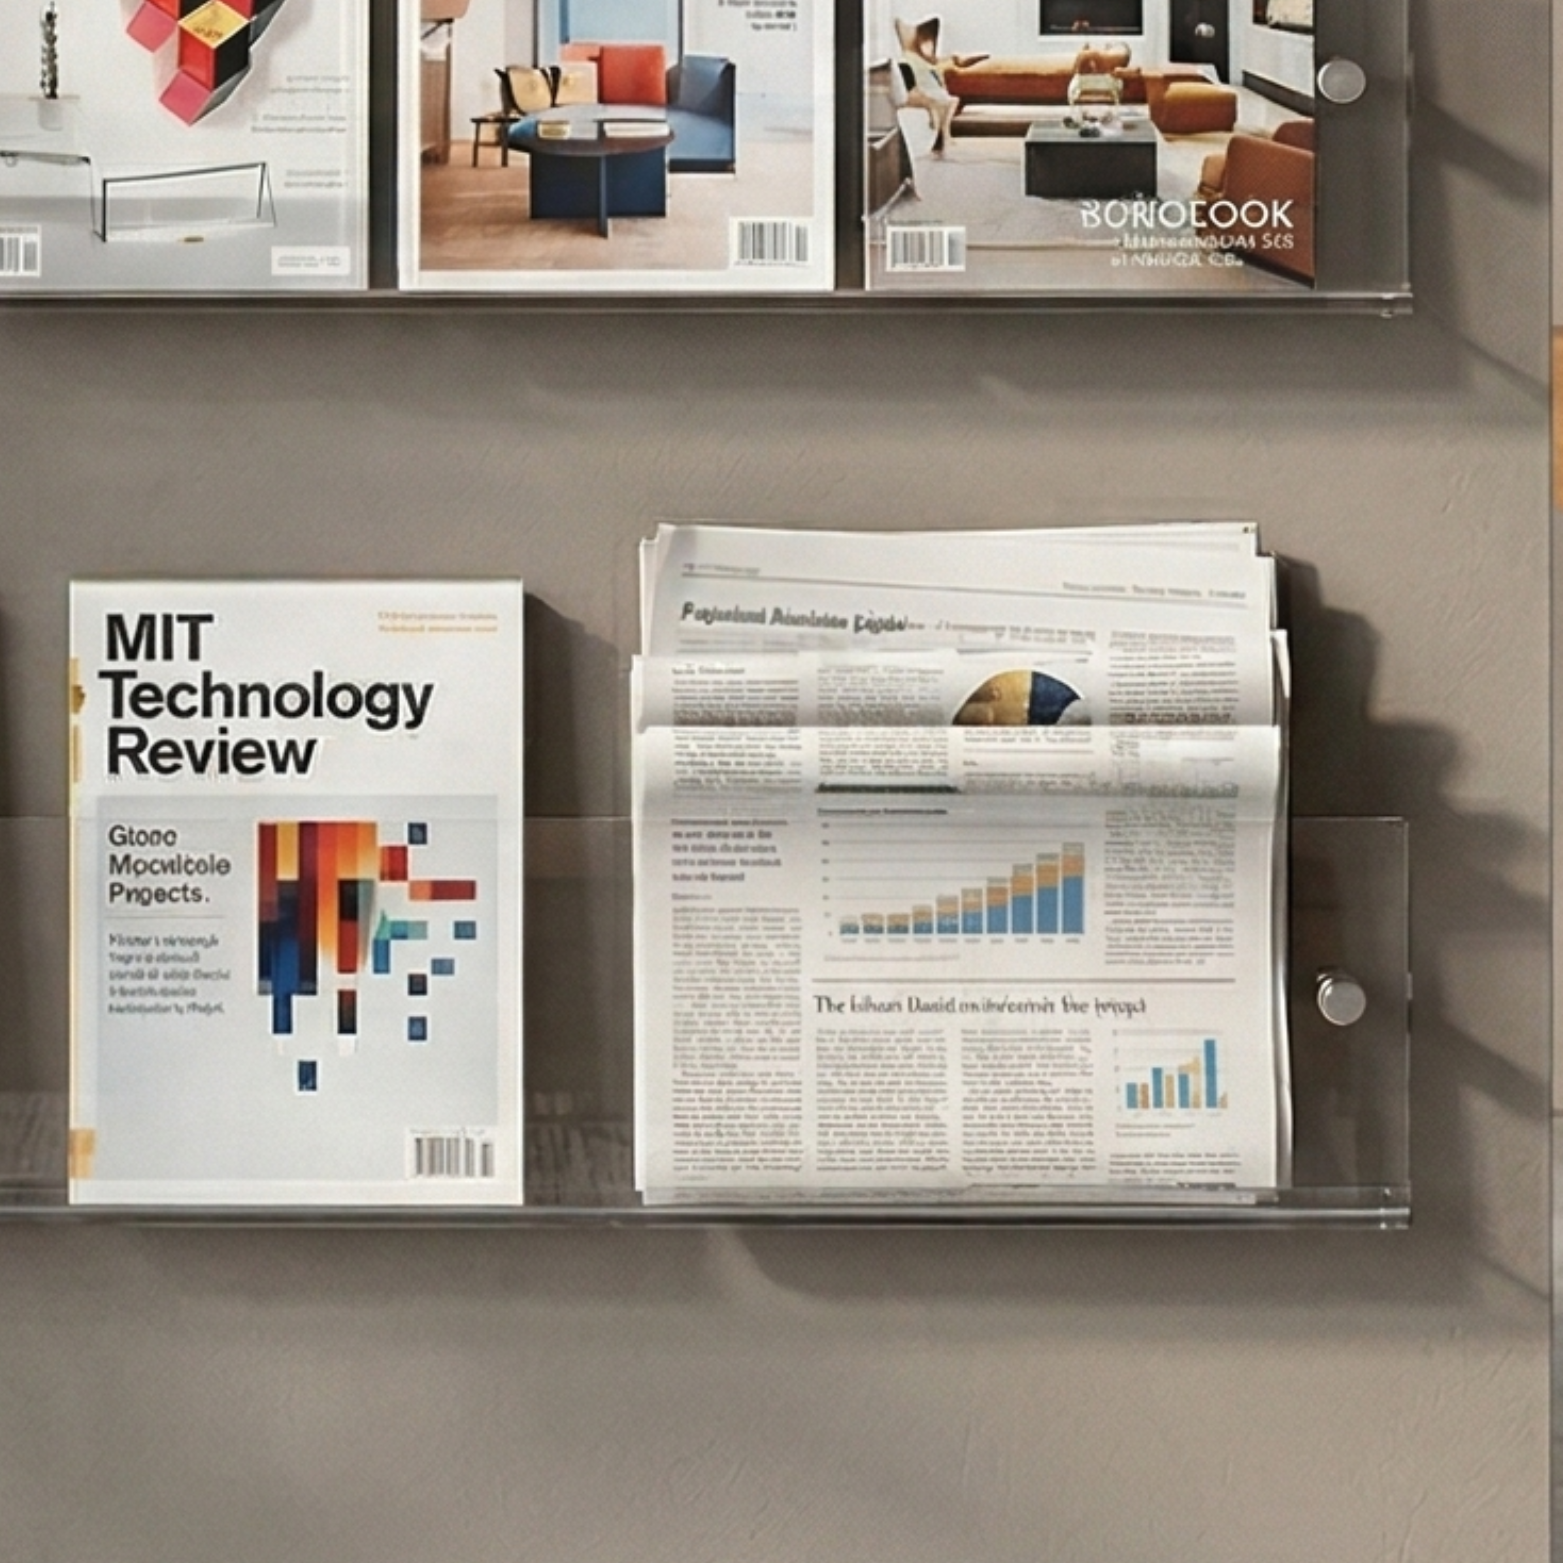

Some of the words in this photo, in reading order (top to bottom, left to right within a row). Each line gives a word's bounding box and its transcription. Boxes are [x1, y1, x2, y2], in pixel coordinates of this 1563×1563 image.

[106, 614, 214, 661] MIT
[99, 670, 434, 730] Technology
[108, 727, 318, 775] Review
